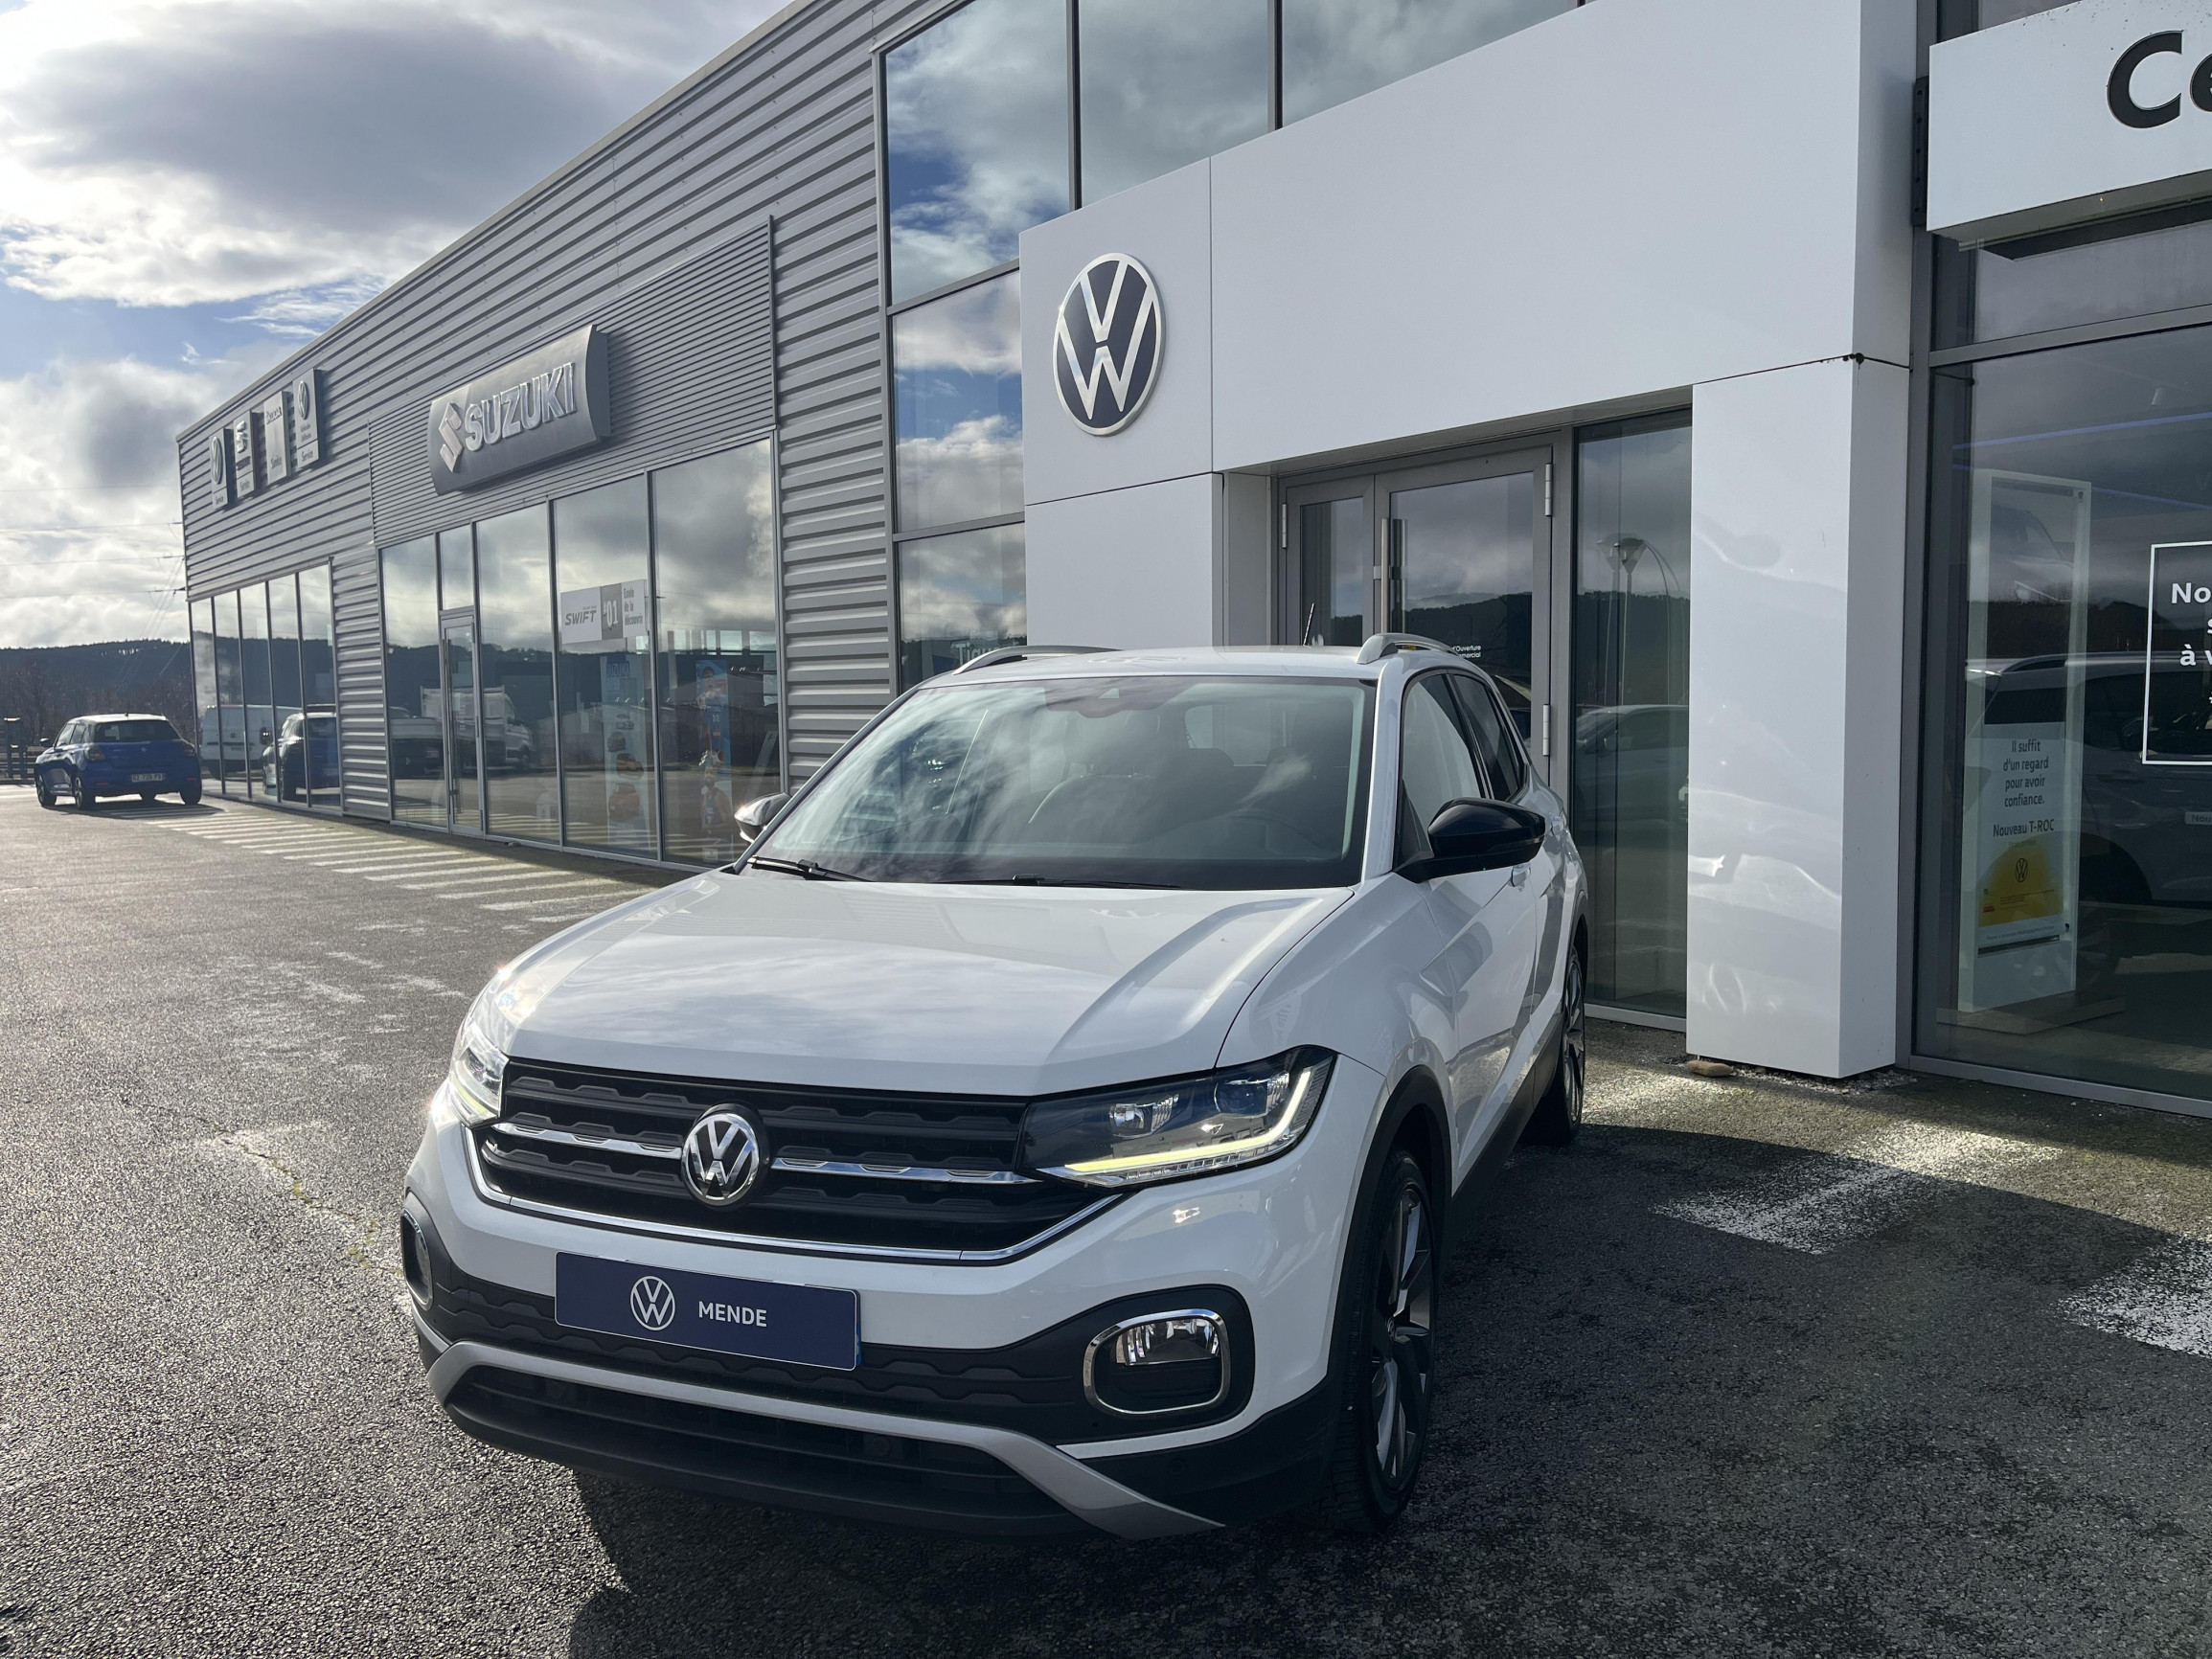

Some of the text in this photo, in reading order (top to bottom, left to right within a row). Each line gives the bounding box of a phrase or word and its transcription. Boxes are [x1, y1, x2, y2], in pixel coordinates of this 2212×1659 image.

[465, 362, 576, 452] SUZUKI
[564, 610, 597, 626] SWIFT
[2179, 644, 2197, 667] à
[2018, 739, 2041, 753] suffit
[2021, 756, 2049, 773] regard
[2005, 774, 2046, 792] pour avoir
[2004, 793, 2045, 807] confiance.
[1993, 818, 2055, 837] Nouveau T-ROC
[697, 1300, 767, 1328] MENDE
